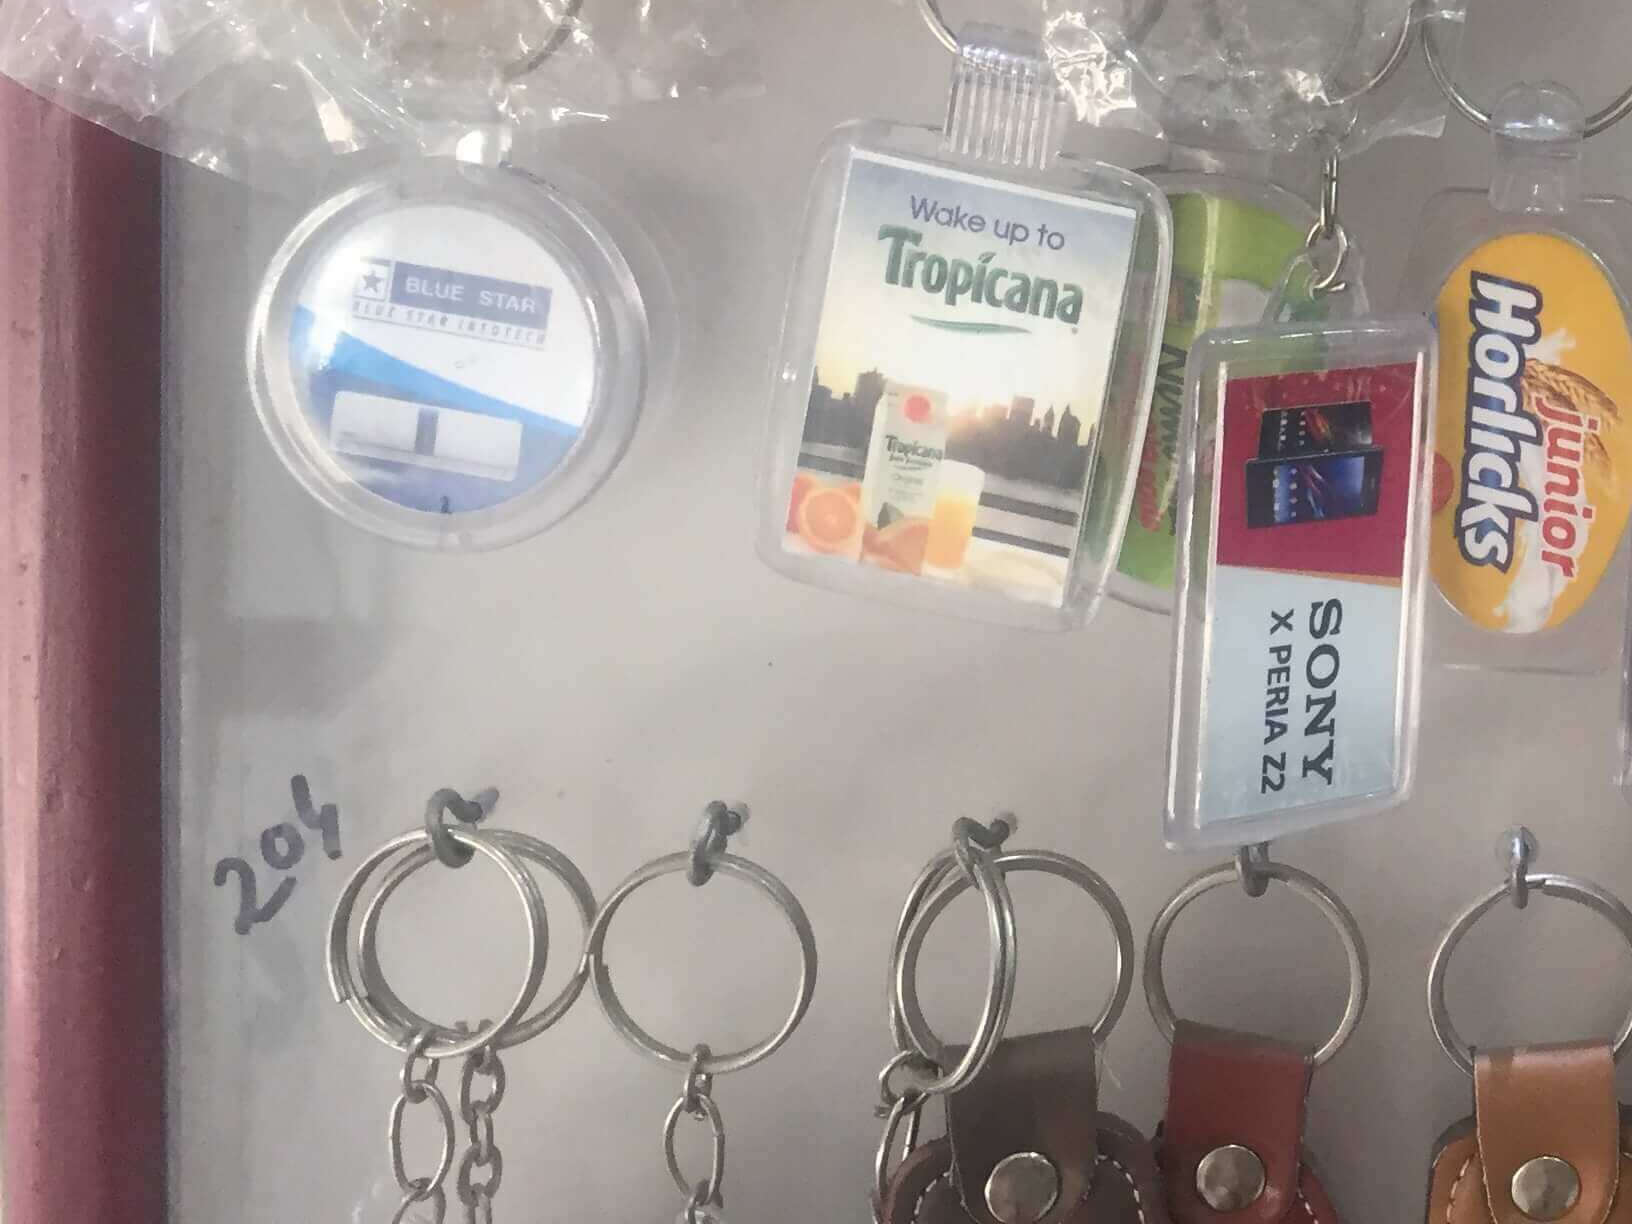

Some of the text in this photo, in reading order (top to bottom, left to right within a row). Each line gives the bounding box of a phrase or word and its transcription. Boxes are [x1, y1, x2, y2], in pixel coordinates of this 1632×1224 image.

[405, 276, 537, 314] BLUE STAR
[877, 223, 1085, 326] Tropicana
[910, 194, 1066, 251] Wake up to
[1455, 272, 1542, 572] Horlicks
[1536, 396, 1598, 578] junior
[1260, 608, 1295, 794] X PERIA Z2
[1302, 598, 1343, 786] SONY
[213, 774, 343, 935] 204
